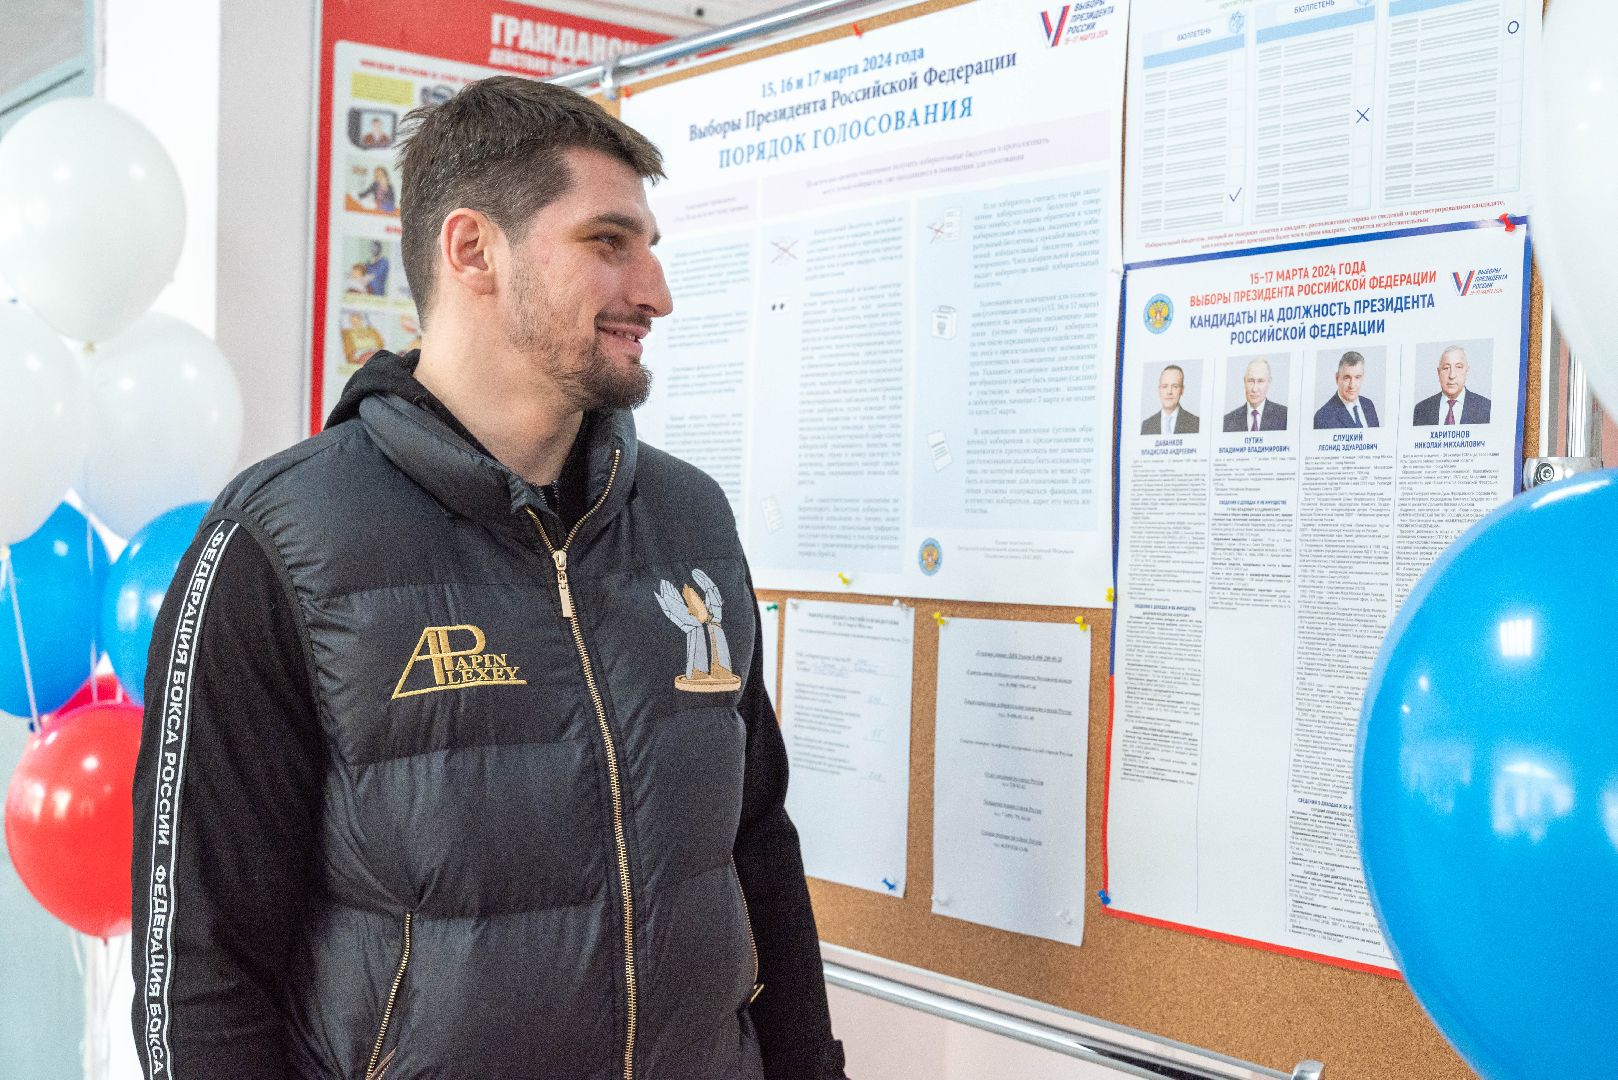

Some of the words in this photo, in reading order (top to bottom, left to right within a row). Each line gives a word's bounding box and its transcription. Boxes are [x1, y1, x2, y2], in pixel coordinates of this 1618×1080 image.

[1294, 0, 1335, 14] БЮЛЛЕТЕНЬ
[761, 81, 777, 98] 15,
[780, 77, 793, 94] 16
[796, 77, 804, 89] и
[808, 69, 821, 88] 17
[823, 63, 860, 84] марта
[862, 51, 892, 73] 2024
[895, 47, 925, 65] года
[689, 117, 741, 141] Выборы
[745, 98, 828, 132] Президента
[831, 71, 918, 109] Российской
[923, 51, 1017, 86] Федерации
[719, 132, 806, 169] ПОРЯДОК
[813, 95, 973, 149] ГОЛОСОВАНИЯ
[1276, 267, 1309, 283] МАРТА
[1312, 264, 1336, 280] 2024
[1338, 260, 1367, 277] ГОДА
[1190, 292, 1231, 307] ВЫБОРЫ
[1234, 286, 1295, 304] ПРЕЗИДЕНТА
[1297, 276, 1366, 297] РОССИЙСКОЙ
[1369, 270, 1437, 291] ФЕДЕРАЦИИ
[1190, 310, 1257, 329] КАНДИДАТЫ
[1260, 307, 1274, 323] НА
[1277, 301, 1350, 323] ДОЛЖНОСТЬ
[1353, 293, 1435, 315] ПРЕЗИДЕНТА
[1230, 323, 1306, 345] РОССИЙСКОЙ
[1309, 319, 1386, 341] ФЕДЕРАЦИИ
[1155, 438, 1183, 447] ДАВАНКОВ
[1244, 436, 1264, 444] ПУТИН
[1318, 444, 1341, 452] ЛЕОНИД
[1342, 443, 1378, 452] ЭДУАРДОВИЧ
[1333, 431, 1363, 442] СЛУЦКИЙ
[1414, 440, 1442, 449] НИКОЛАЙ
[1443, 439, 1486, 449] МИХАЙЛОВИЧ
[1430, 430, 1470, 440] ХАРИТОНОВ
[1141, 448, 1168, 456] ВЛАДИСЛАВ
[1169, 447, 1197, 456] АНДРЕЕВИЧ
[1218, 446, 1247, 454] ВЛАДИМИР
[1248, 445, 1291, 453] ВЛАДИМИРОВИЧ
[175, 530, 225, 665] ФЕДЕРАЦИЯ
[165, 671, 186, 745] БОКСА
[158, 751, 177, 846] РОССИИ
[148, 864, 168, 998] ФЕДЕРАЦИЯ
[148, 1002, 165, 1075] БОКСА
